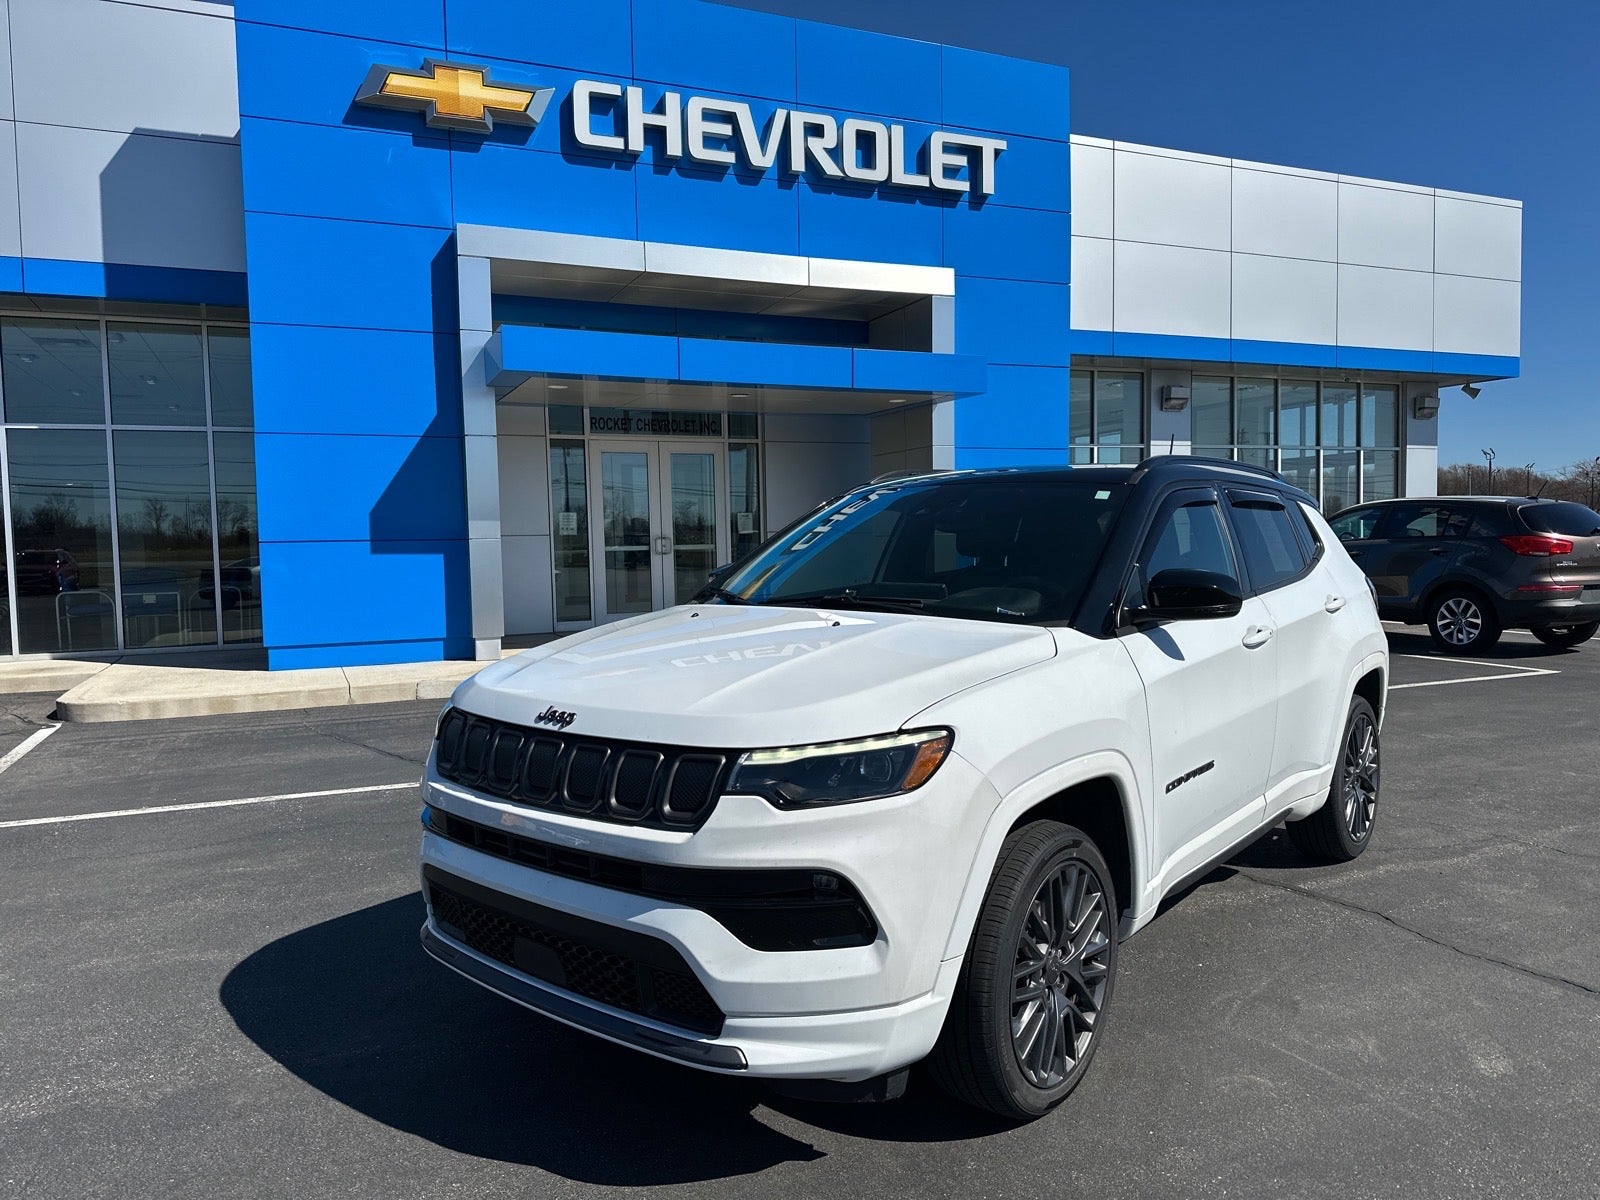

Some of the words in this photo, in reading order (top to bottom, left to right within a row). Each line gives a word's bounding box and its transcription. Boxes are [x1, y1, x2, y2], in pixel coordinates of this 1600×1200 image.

[572, 79, 1008, 196] CHEVROLET
[590, 417, 633, 431] ROCKET
[534, 705, 577, 730] Jeep
